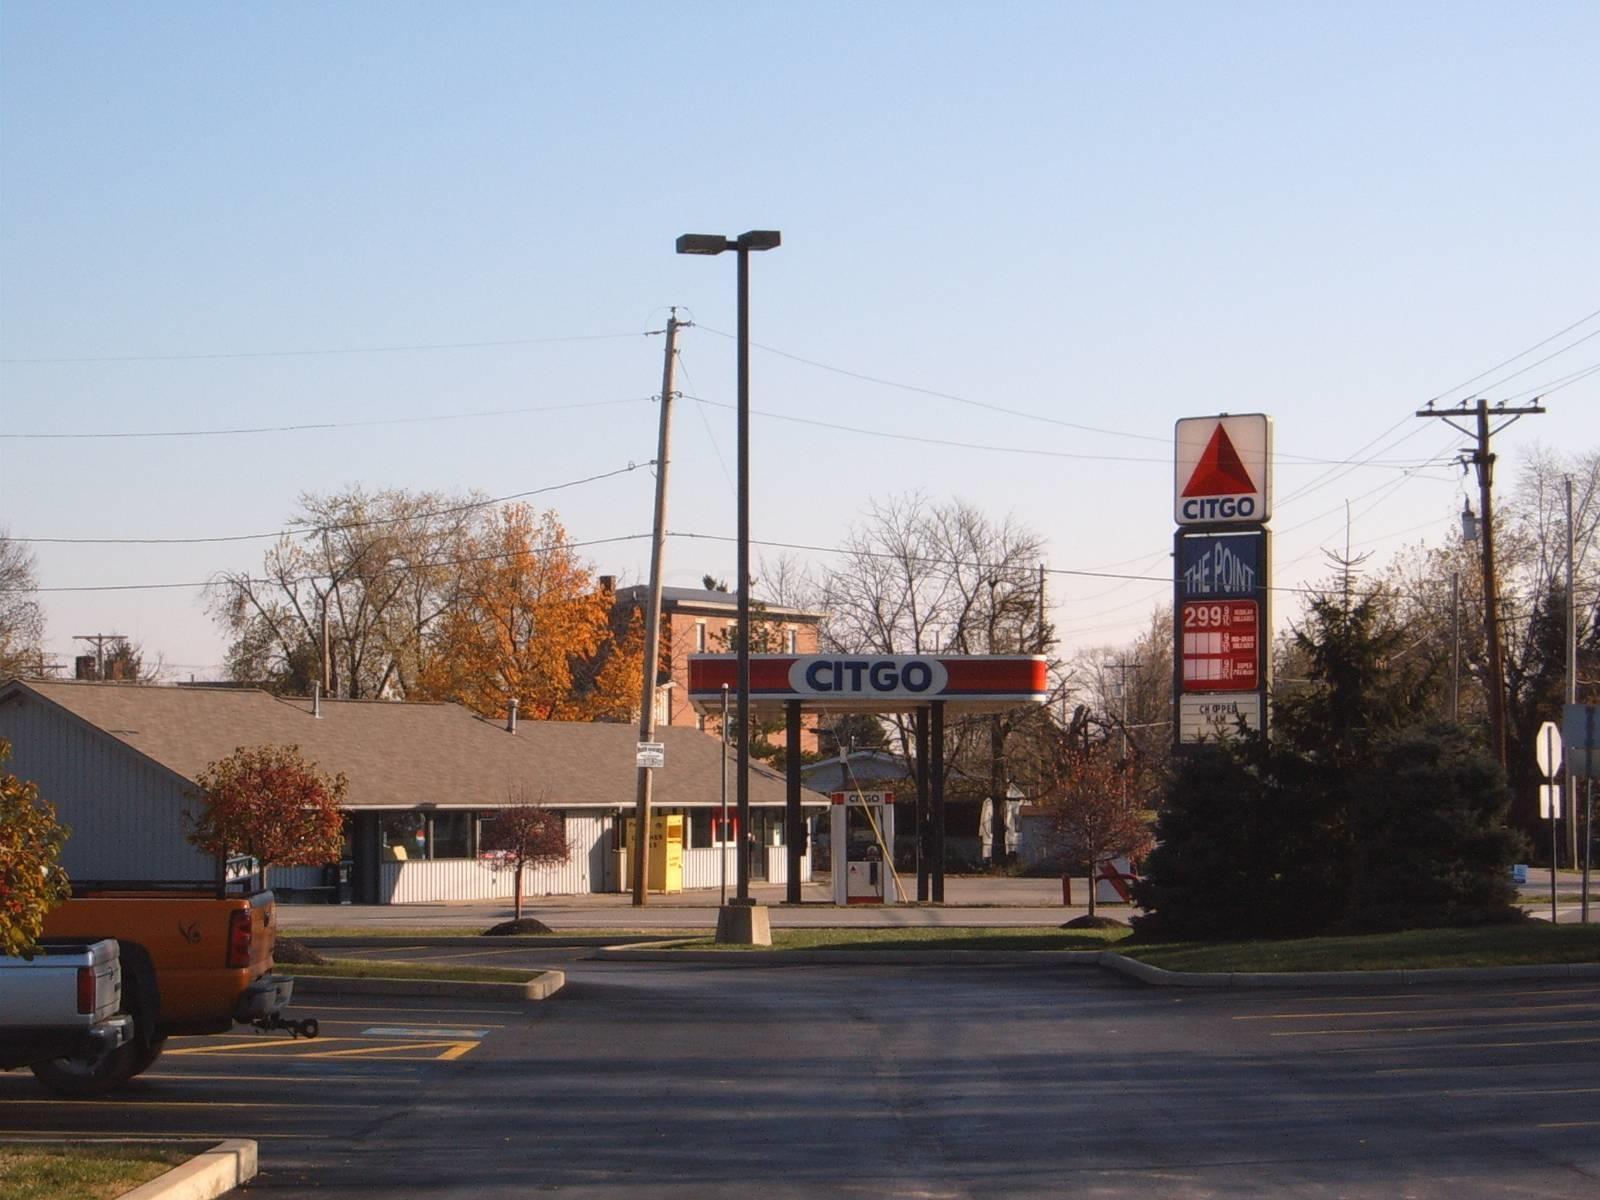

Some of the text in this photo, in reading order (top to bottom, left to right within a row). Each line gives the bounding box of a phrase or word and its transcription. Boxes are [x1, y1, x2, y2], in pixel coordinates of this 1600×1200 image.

[1183, 497, 1255, 519] CITGO
[1184, 541, 1254, 593] THE POINT
[1184, 606, 1221, 627] 299
[806, 660, 932, 692] CITGO
[1206, 714, 1226, 724] HAM
[849, 794, 880, 803] CIGO
